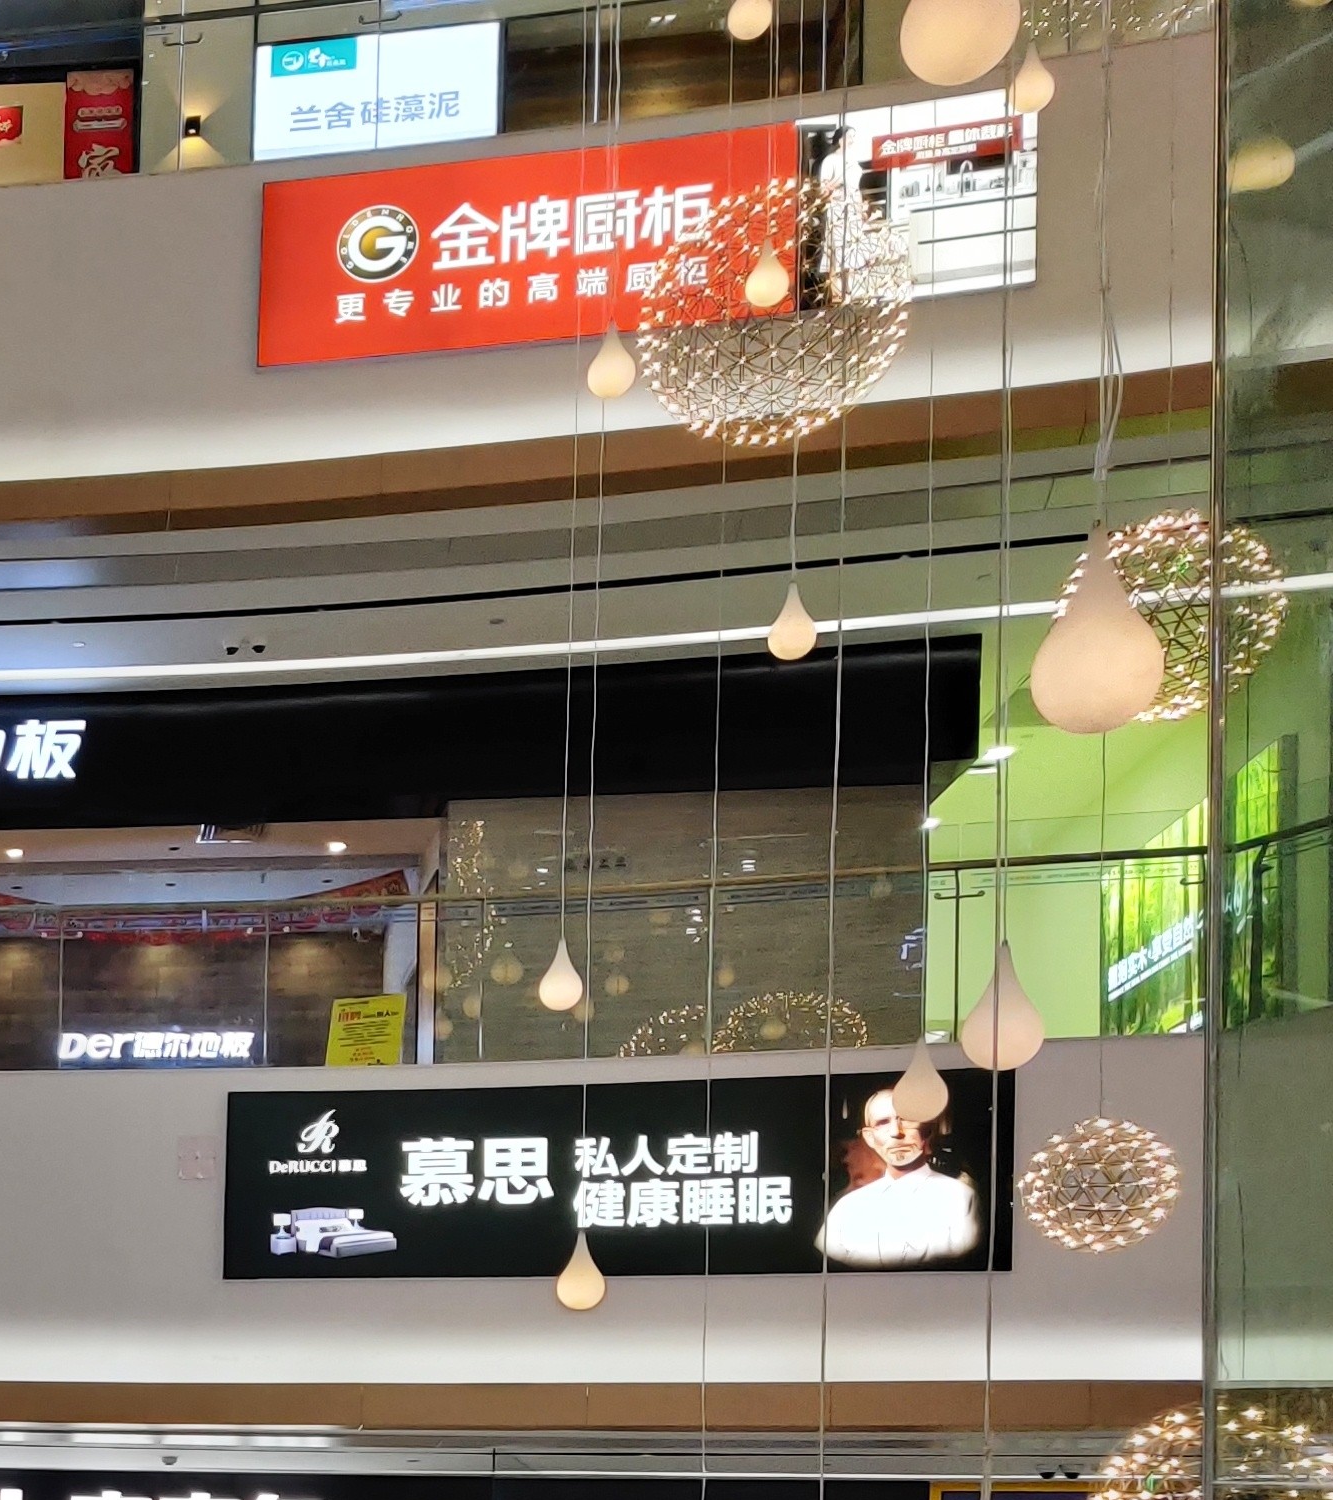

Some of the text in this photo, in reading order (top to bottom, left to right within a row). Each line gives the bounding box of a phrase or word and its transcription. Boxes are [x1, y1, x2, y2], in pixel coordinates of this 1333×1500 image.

[290, 91, 460, 132] 兰舍硅藻泥
[431, 183, 715, 271] 金牌厨柜
[334, 256, 710, 325] 更专业的高端厨柜
[57, 1030, 256, 1060] Der德尔地板
[400, 1137, 555, 1206] 慕思
[575, 1131, 760, 1177] 私人定制
[573, 1175, 793, 1229] 健康睡眠
